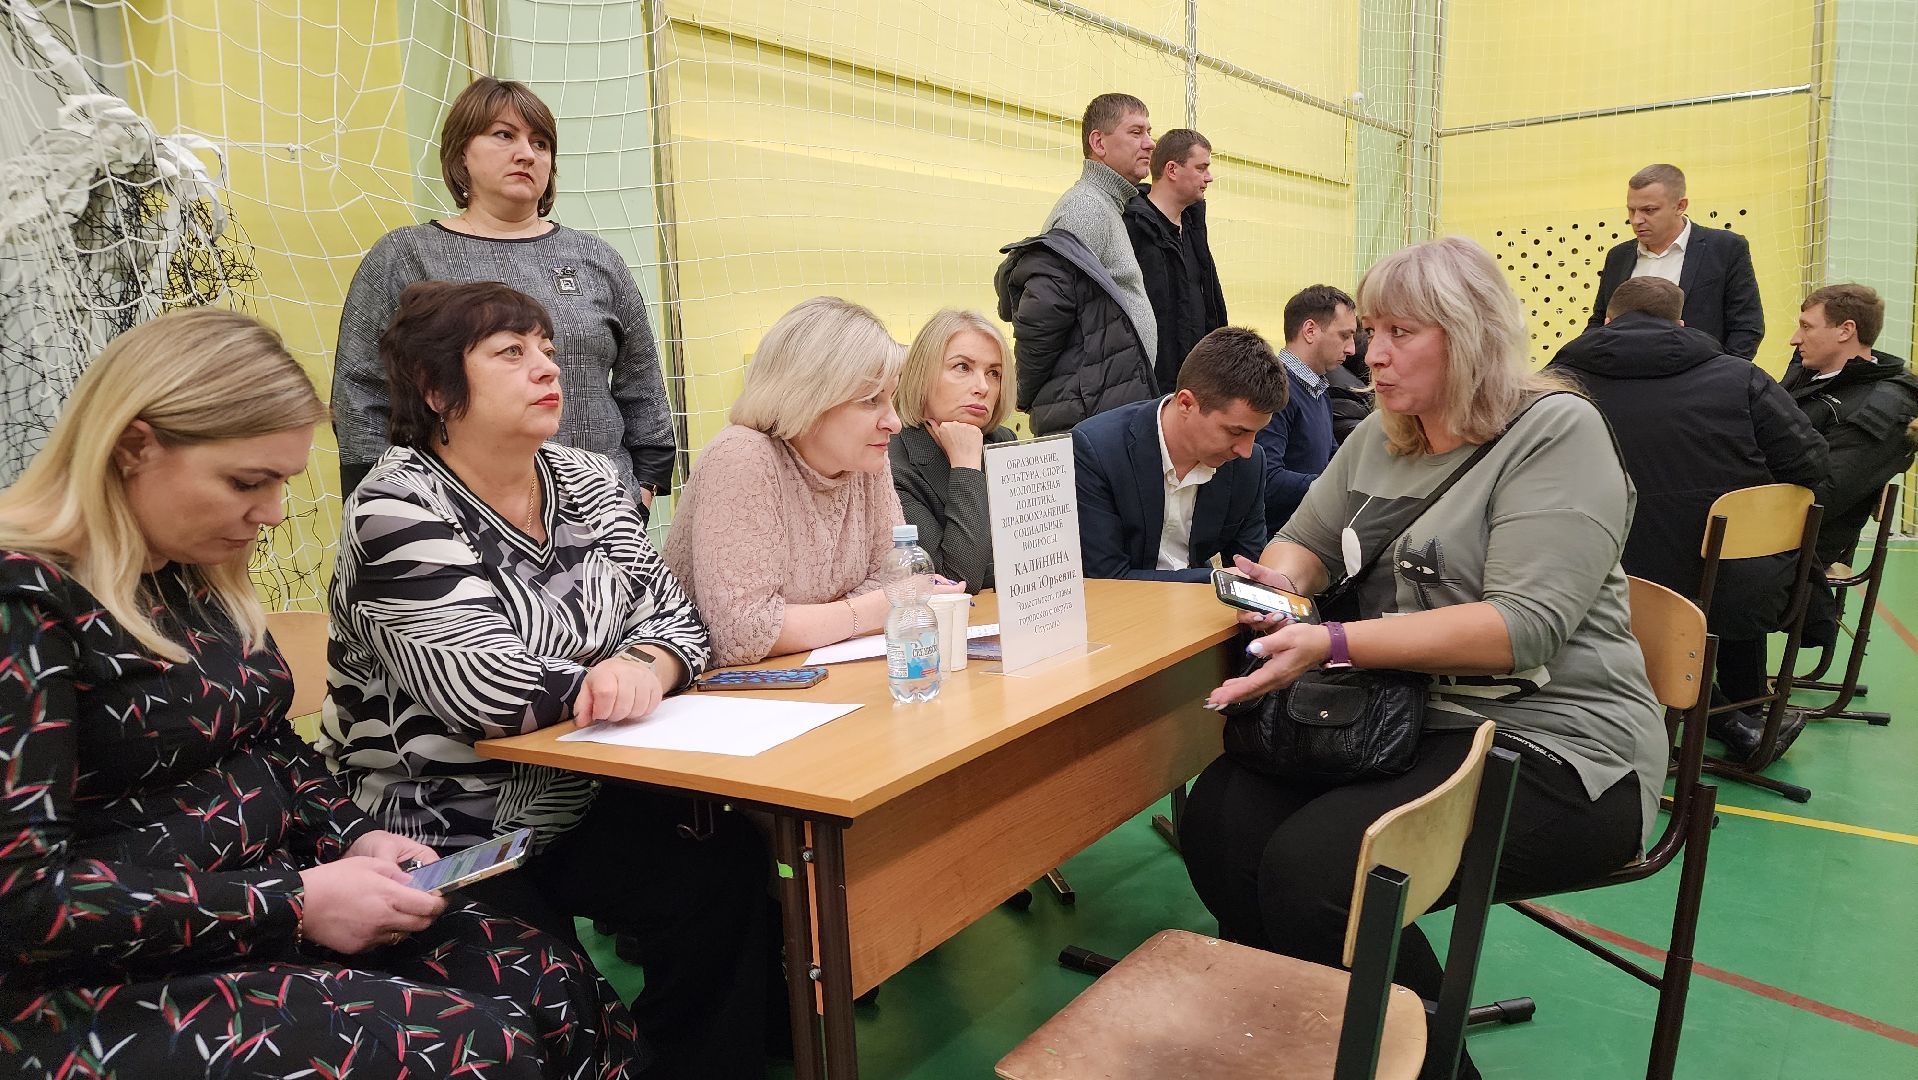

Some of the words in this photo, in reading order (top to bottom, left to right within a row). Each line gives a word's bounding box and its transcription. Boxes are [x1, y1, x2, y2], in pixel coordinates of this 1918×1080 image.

[1014, 550, 1070, 577] КАЛИНИНА
[1009, 581, 1037, 598] Юлия
[1039, 569, 1077, 590] Юрьевна
